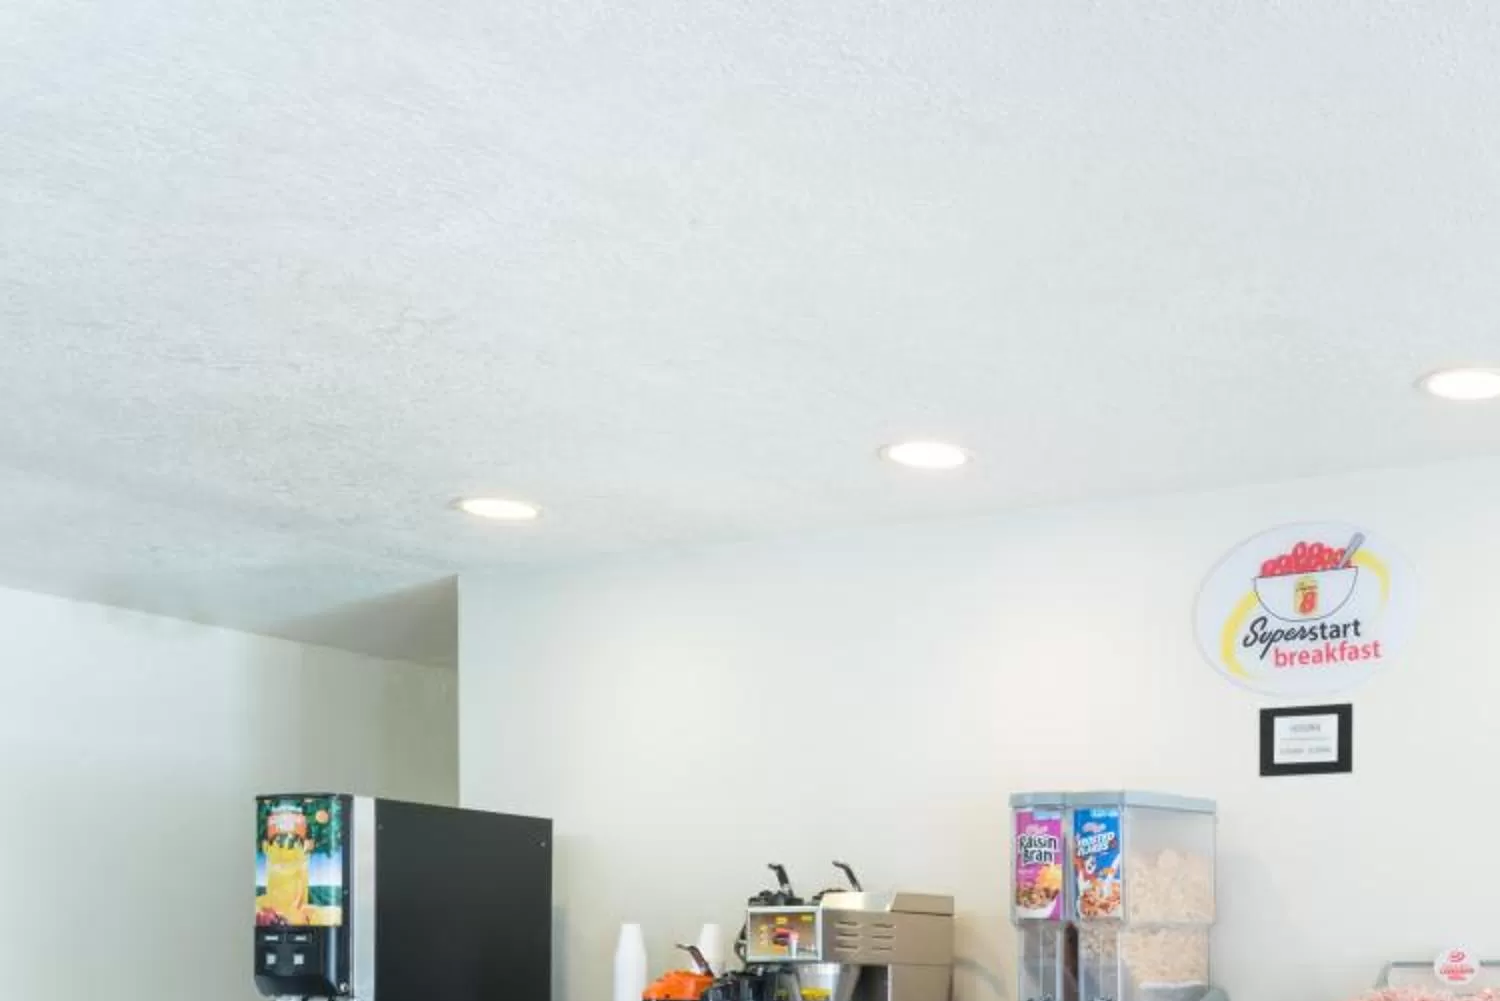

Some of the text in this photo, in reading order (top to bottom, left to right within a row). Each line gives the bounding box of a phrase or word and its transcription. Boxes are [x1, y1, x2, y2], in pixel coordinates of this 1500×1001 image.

[1243, 616, 1362, 660] Superstart
[1273, 640, 1382, 668] breakfast
[1019, 834, 1058, 850] Raisin
[1023, 849, 1054, 864] Bran
